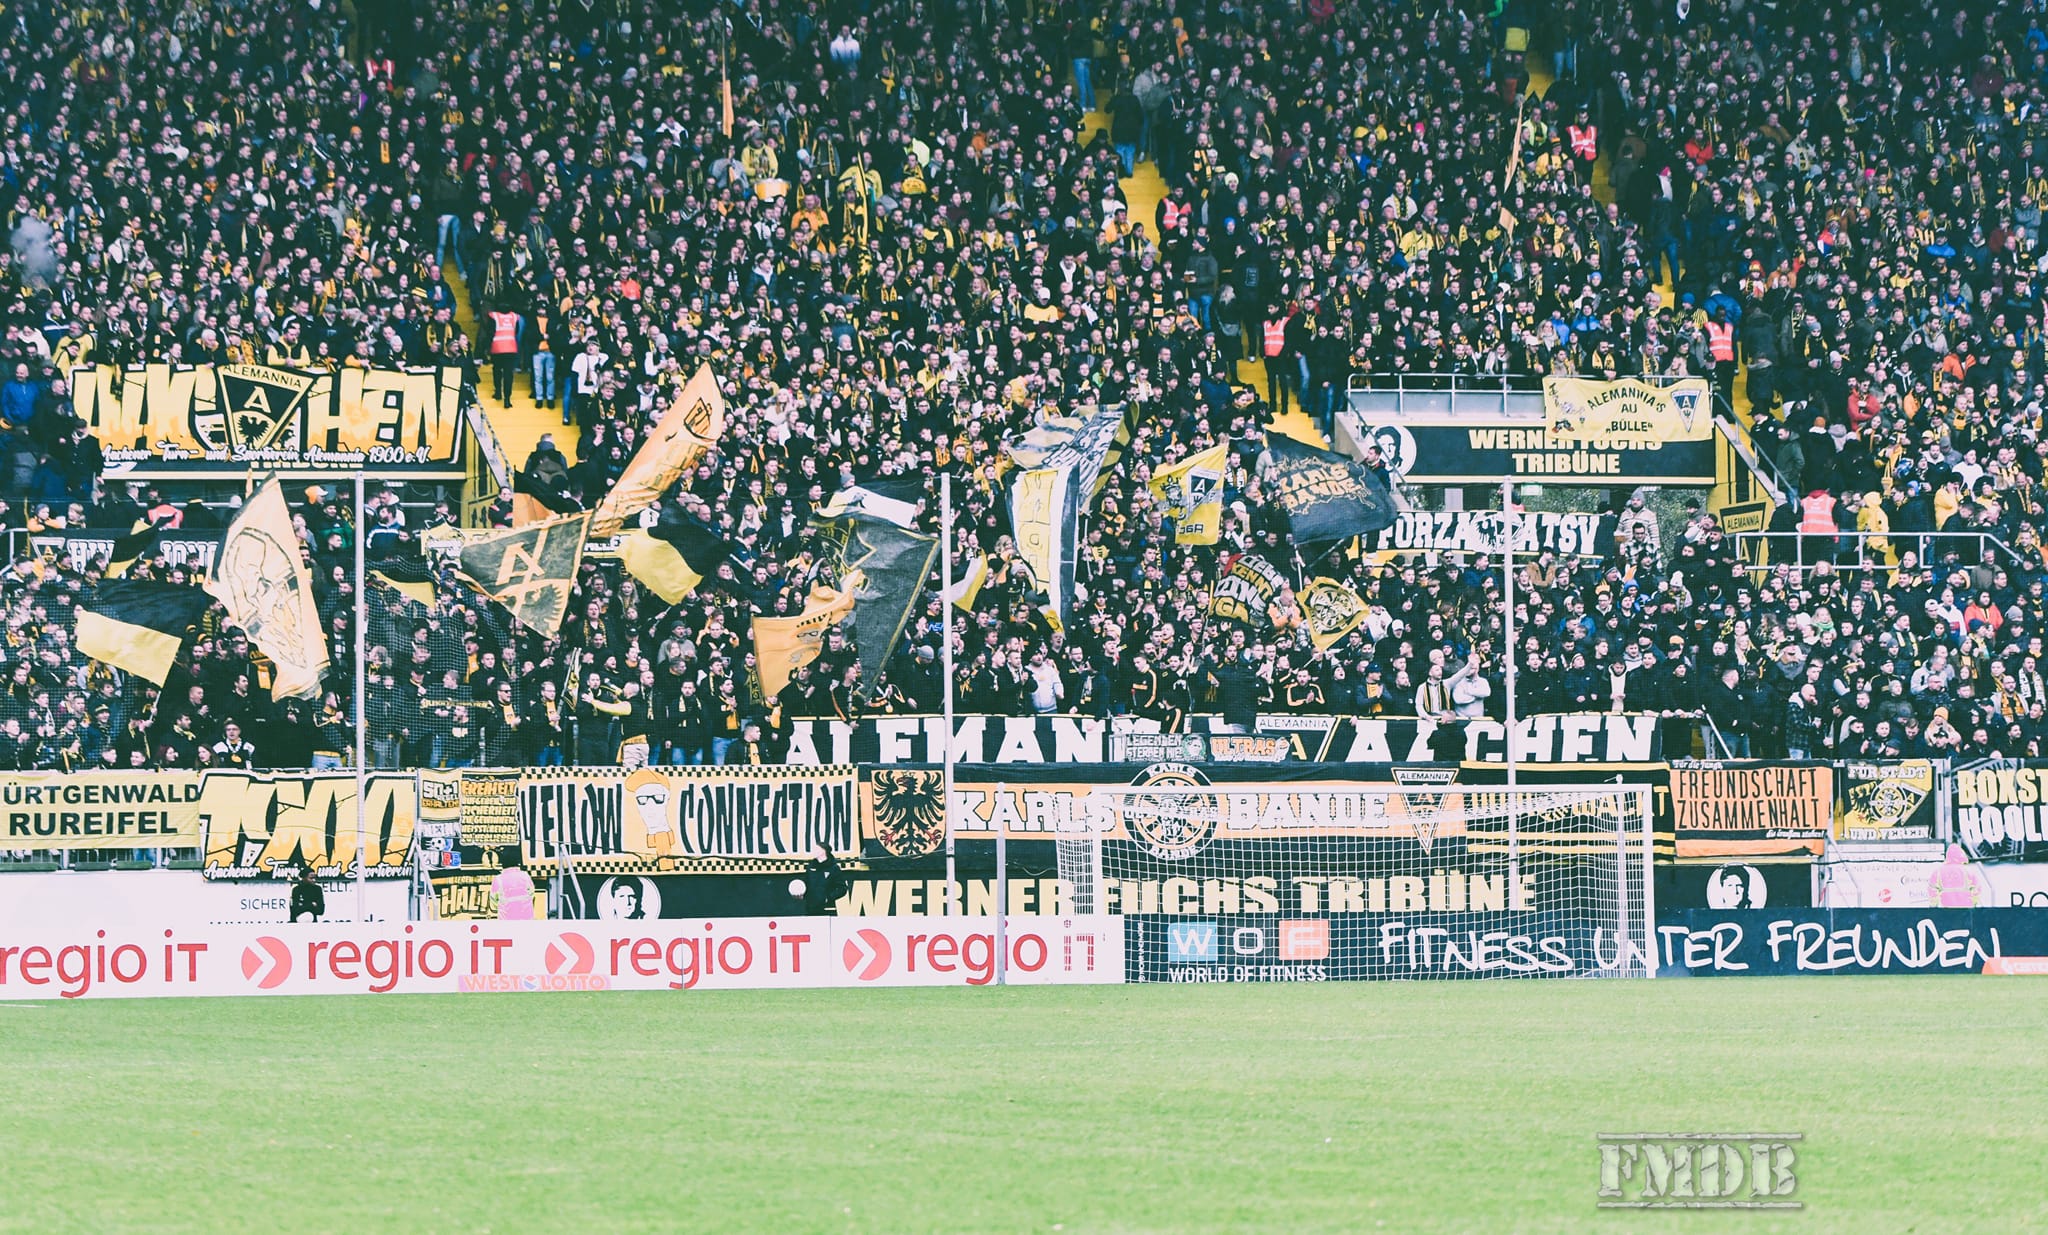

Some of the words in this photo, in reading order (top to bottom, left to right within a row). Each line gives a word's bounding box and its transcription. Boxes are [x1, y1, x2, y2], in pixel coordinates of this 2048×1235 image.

[223, 364, 302, 389] ALEMANNIA
[1620, 402, 1638, 414] AU
[101, 443, 151, 463] Aachener
[155, 440, 200, 462] Turn-
[205, 444, 228, 462] und
[231, 443, 299, 464] Sportverein
[303, 443, 365, 463] Alemannia
[368, 446, 404, 464] 1900
[1512, 449, 1621, 474] TRIBÜNE
[1378, 509, 1472, 550] FORZA
[1726, 514, 1760, 530] ALEMANNIA
[1259, 717, 1330, 729] ALEMANNIA
[1210, 737, 1277, 755] ULTRAS
[1399, 771, 1450, 781] ALEMANNIA
[1679, 769, 1817, 799] FREUNDSCHAFT
[1847, 764, 1878, 779] FÜR
[1880, 765, 1927, 779] STADT
[3, 781, 200, 805] ÜRTGENWALD
[9, 811, 179, 836] RUREIFEL
[202, 774, 415, 869] 1900
[521, 782, 623, 858] YELLOW
[680, 779, 852, 855] CONNECTION
[954, 791, 1117, 833] KARLS
[1227, 792, 1390, 830] BANDE
[1677, 799, 1819, 829] ZUSAMMENHALT
[1849, 827, 1878, 840] UND
[203, 859, 261, 880] Aachener
[317, 861, 341, 878] und
[344, 860, 413, 879] Sortverein
[240, 898, 286, 910] SICHER
[440, 884, 498, 915] HALT
[835, 879, 1074, 917] WERNER
[1102, 876, 1280, 915] FUCHS
[1292, 869, 1537, 914] TRIBÜNE
[610, 922, 753, 990] regio
[1379, 921, 1575, 972] FITNESS
[1593, 922, 1750, 971] UNTER
[1767, 919, 2001, 971] FREUNDEN
[0, 929, 148, 998] regio
[308, 925, 453, 993] regio
[464, 975, 520, 991] WEST
[540, 975, 606, 991] LOTTO
[1169, 966, 1228, 983] WORLD
[1233, 966, 1256, 982] OF
[1258, 965, 1327, 982] FITNESS
